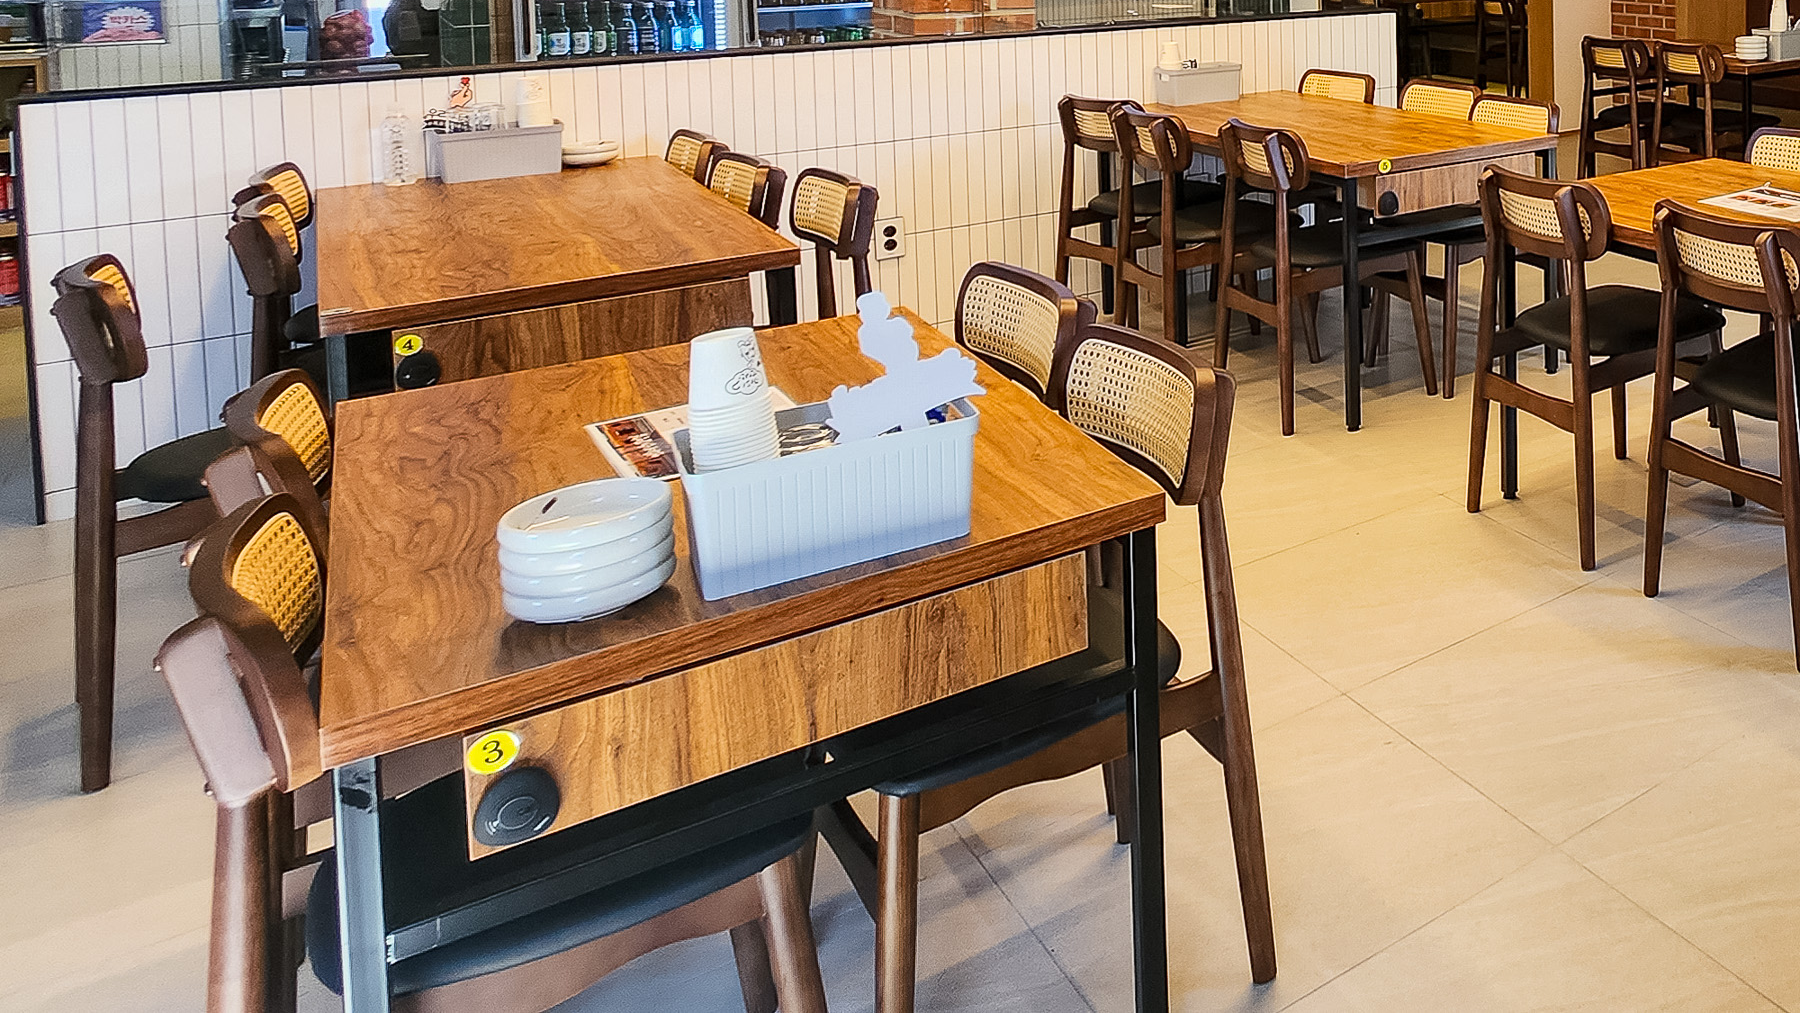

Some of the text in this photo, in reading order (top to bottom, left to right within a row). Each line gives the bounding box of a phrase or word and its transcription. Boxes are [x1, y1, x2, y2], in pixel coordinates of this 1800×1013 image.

[1381, 161, 1389, 171] 5
[402, 338, 415, 351] 4
[482, 739, 504, 764] 3
